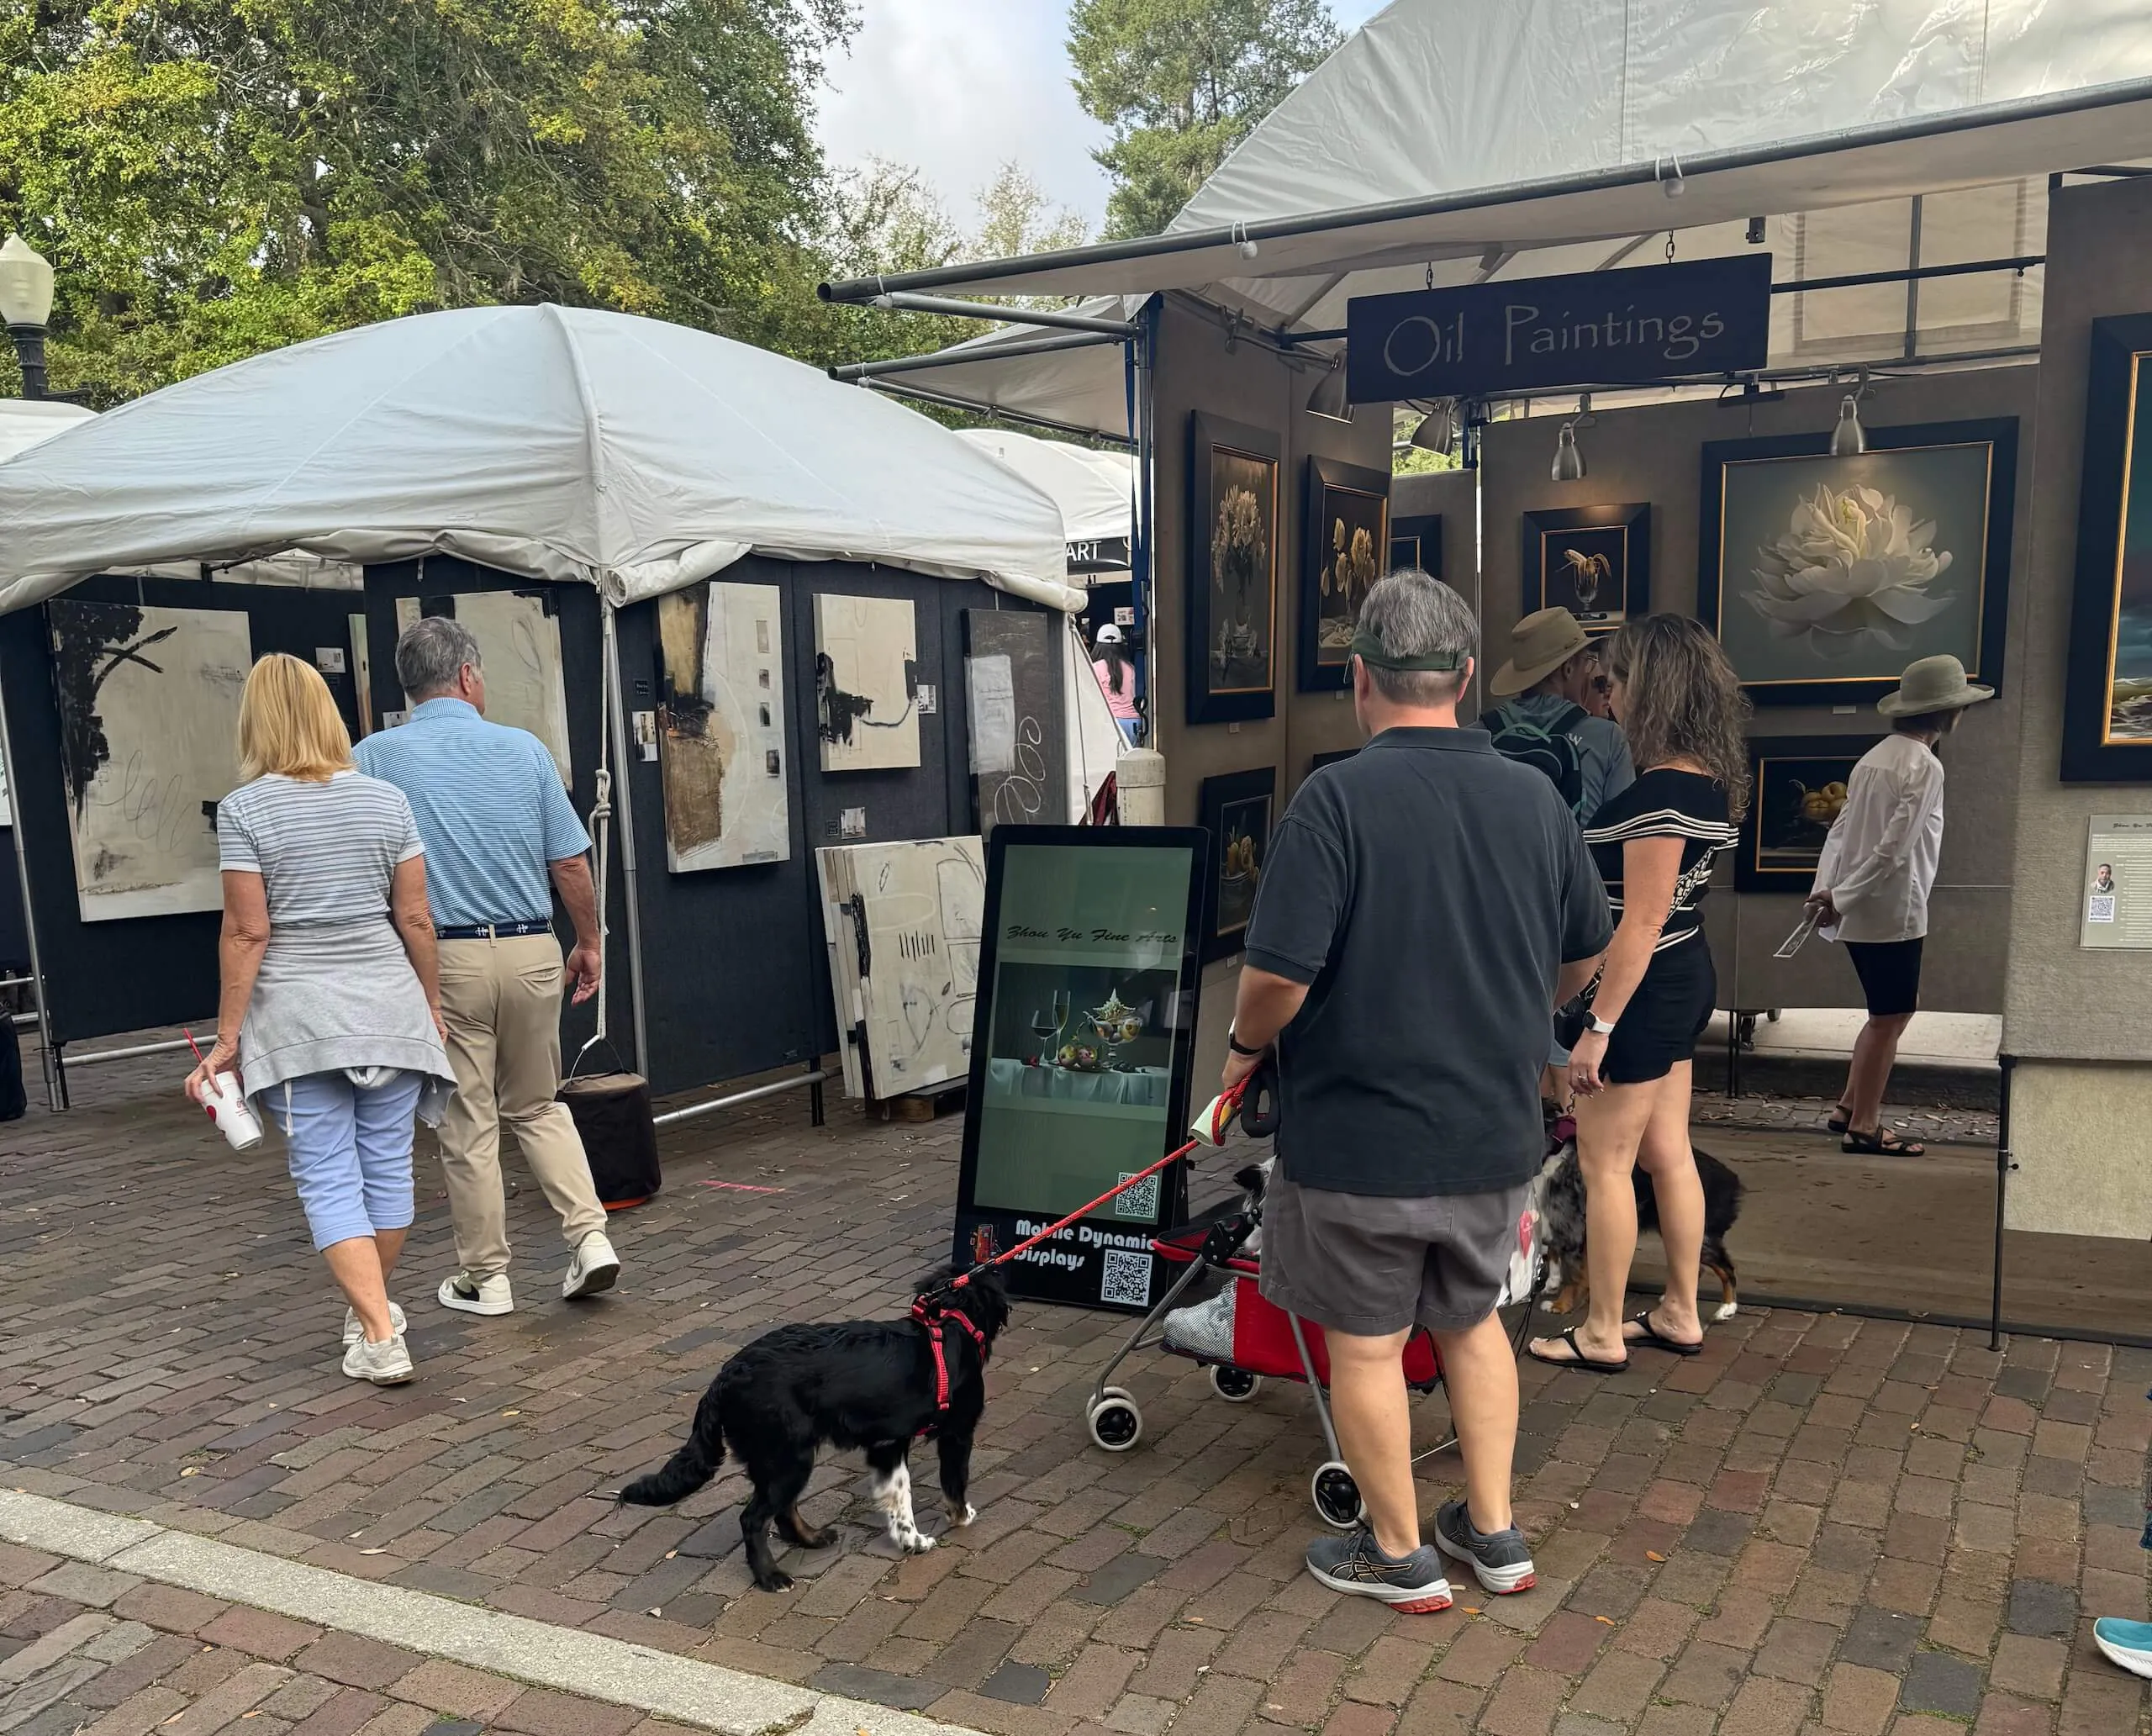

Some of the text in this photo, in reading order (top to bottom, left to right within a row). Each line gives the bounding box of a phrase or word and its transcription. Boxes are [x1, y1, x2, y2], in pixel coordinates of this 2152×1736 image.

[1383, 305, 1724, 376] Oil Paintings
[1007, 926, 1178, 943] Zhou Yu Fine Arts
[1079, 1226, 1157, 1252] Dynamic
